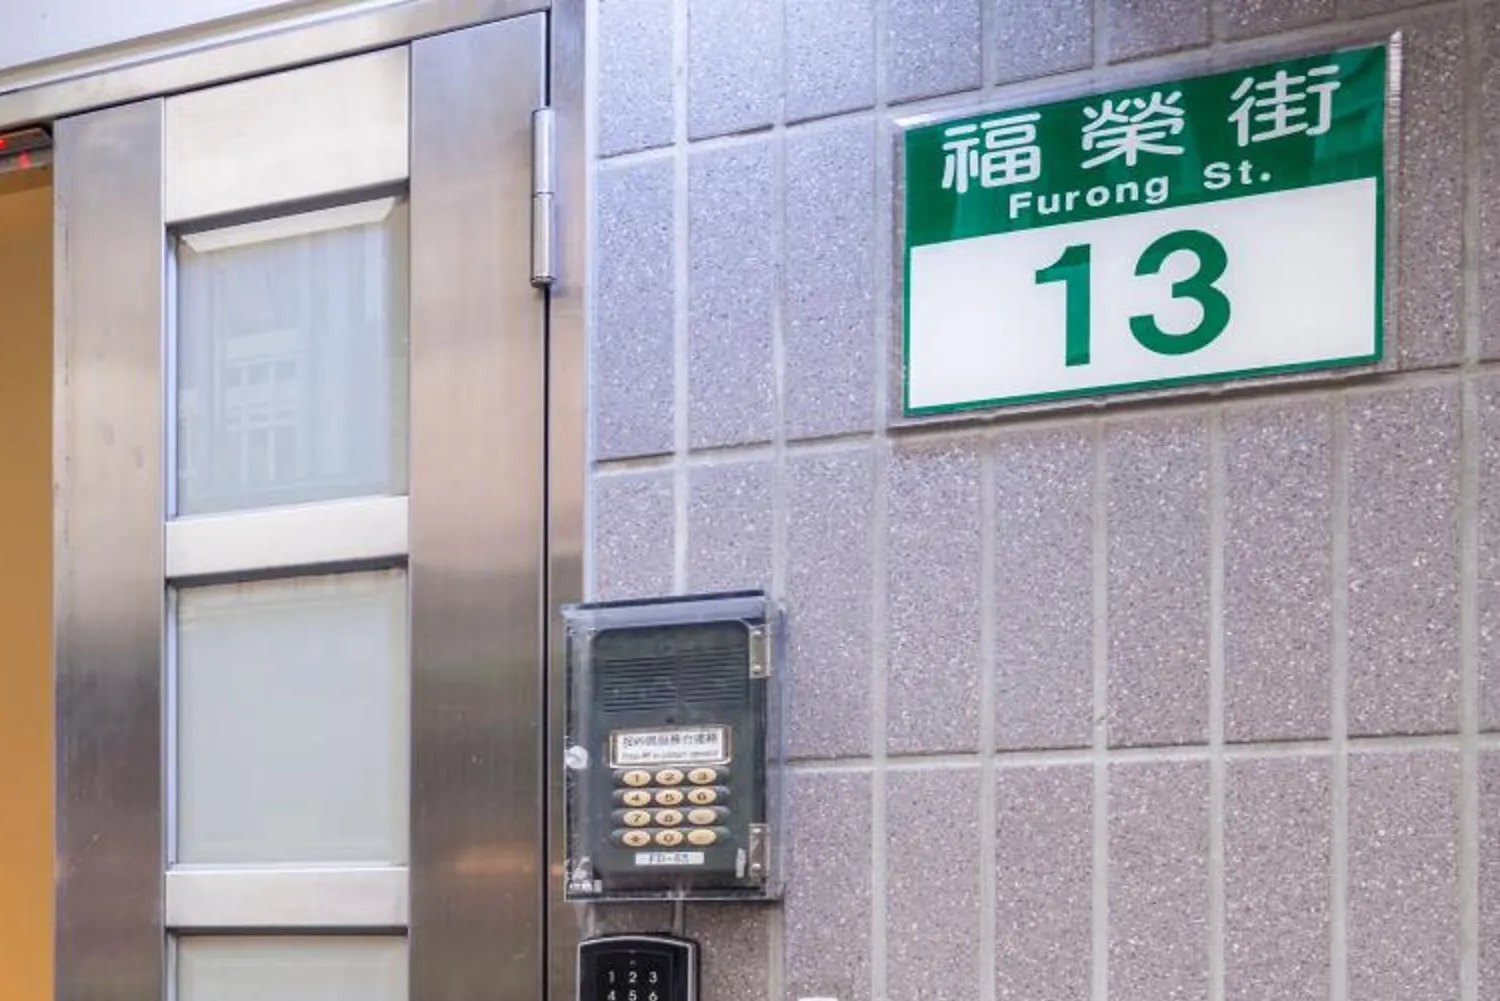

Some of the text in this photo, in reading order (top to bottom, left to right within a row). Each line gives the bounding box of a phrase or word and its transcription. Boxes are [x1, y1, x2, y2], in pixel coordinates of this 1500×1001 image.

[942, 64, 1341, 194] 福榮街
[1008, 160, 1273, 220] Furong St.
[1033, 228, 1232, 368] 13
[607, 989, 616, 1001] 4
[608, 970, 658, 984] 1 2 3
